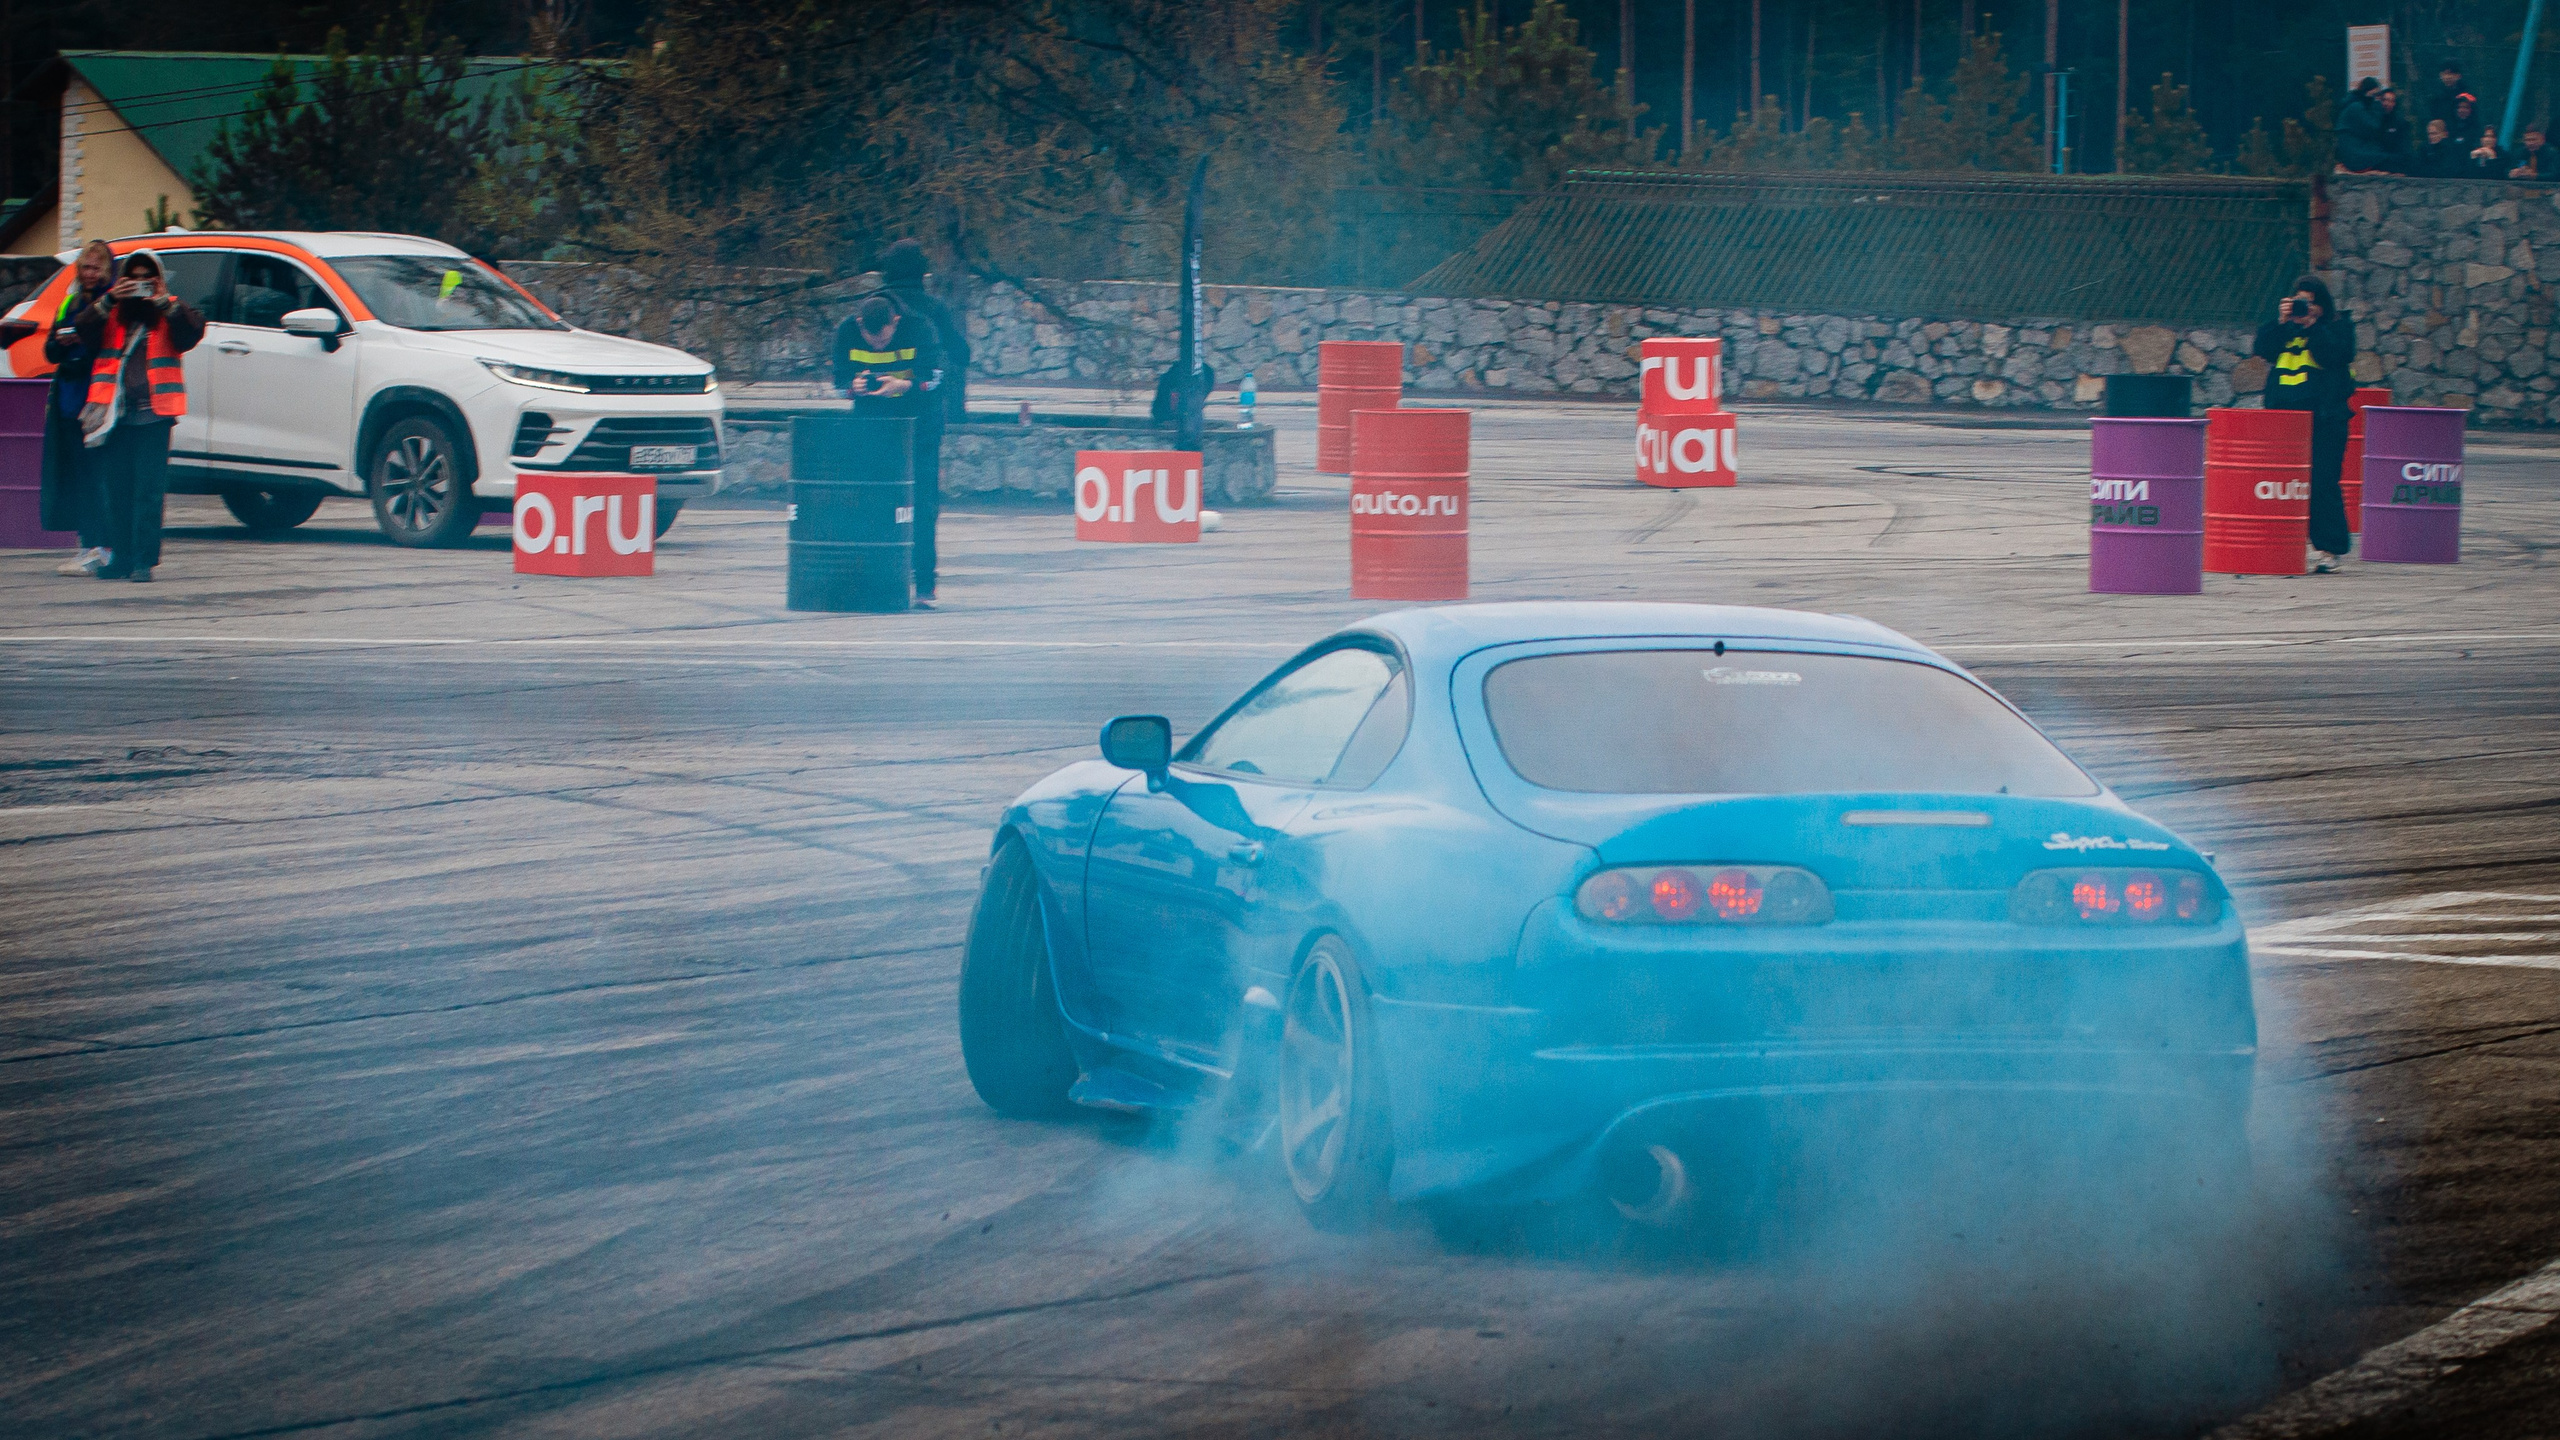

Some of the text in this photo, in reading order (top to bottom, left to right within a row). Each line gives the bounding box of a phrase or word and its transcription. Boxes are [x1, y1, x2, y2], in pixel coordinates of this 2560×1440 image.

[513, 491, 654, 555] o.ru
[1075, 466, 1199, 524] o.ru
[1352, 491, 1459, 516] auto.ru
